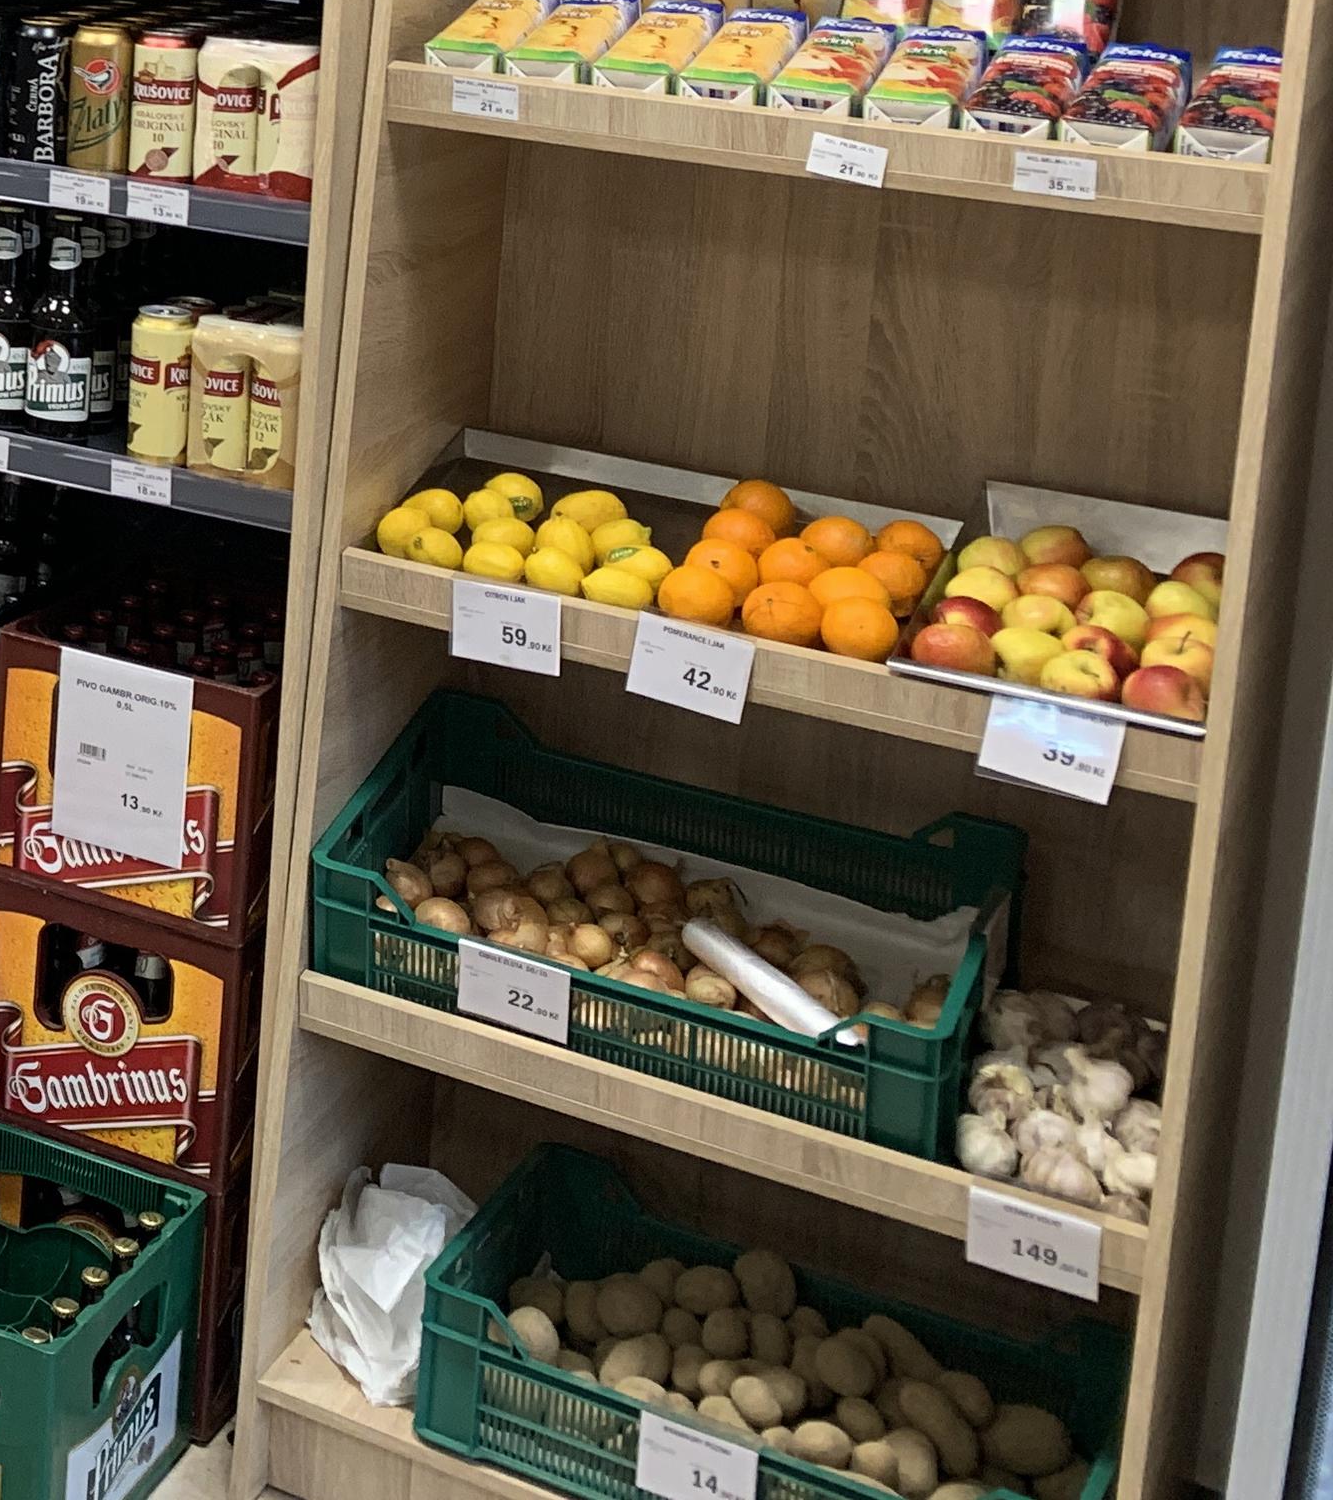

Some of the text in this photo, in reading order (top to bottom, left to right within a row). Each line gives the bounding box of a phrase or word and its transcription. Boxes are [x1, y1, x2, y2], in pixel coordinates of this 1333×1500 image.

[653, 1, 712, 16] Relax
[734, 11, 795, 25] Relax
[910, 27, 976, 41] Relax
[1008, 37, 1077, 57] Relax
[1108, 45, 1182, 65] Relax
[1225, 50, 1282, 65] Rela
[133, 80, 191, 101] KRUŠOVICE
[34, 51, 60, 164] BARBORA
[27, 372, 85, 408] Primus
[663, 624, 707, 645] POMERANCE
[76, 678, 97, 692] PIVO
[7, 1059, 188, 1114] Gambrinus
